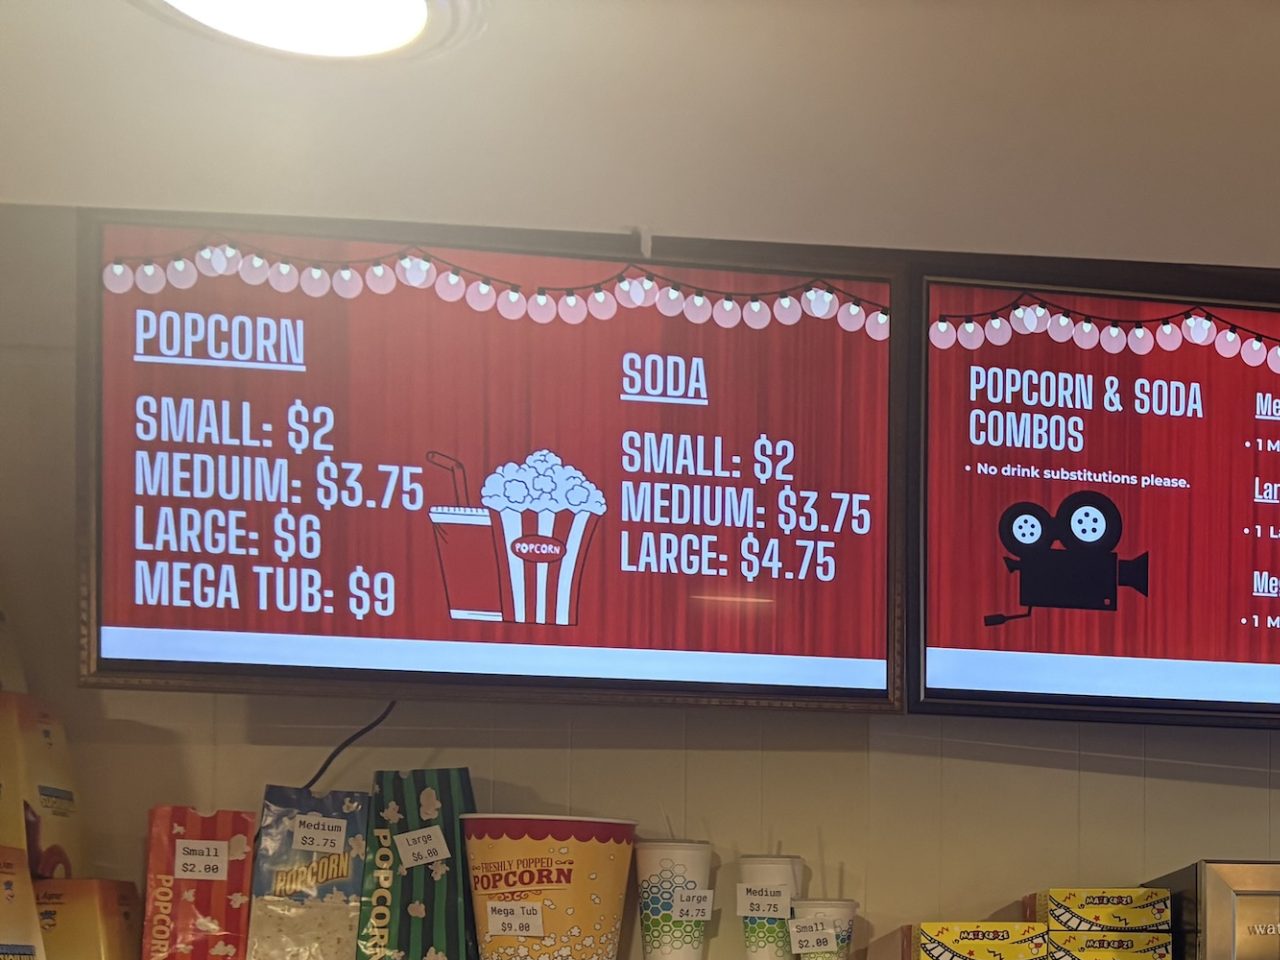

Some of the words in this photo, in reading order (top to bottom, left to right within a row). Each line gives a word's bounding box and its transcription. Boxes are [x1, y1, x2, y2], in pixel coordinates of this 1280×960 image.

[135, 308, 305, 364] POPCORN
[621, 351, 708, 399] SODA
[969, 365, 1094, 410] POPCORN
[1103, 375, 1123, 412] &
[1133, 377, 1204, 418] SODA
[135, 394, 273, 448] SMALL:
[287, 398, 336, 455] $2
[969, 408, 1085, 452] COMBOS
[1256, 438, 1264, 452] 1
[621, 430, 742, 479] SMALL:
[753, 432, 795, 485] $2
[134, 449, 302, 504] MEDUIM:
[316, 454, 424, 511] $3.75
[977, 462, 998, 476] No
[1001, 463, 1041, 479] drink
[1043, 466, 1139, 486] substitutions
[1140, 473, 1191, 489] please.
[620, 480, 766, 530] MEDIUM:
[777, 484, 871, 535] $3.75
[134, 504, 260, 556] LARGE:
[273, 507, 322, 563] $6
[1254, 524, 1263, 538] 1
[514, 541, 562, 556] POPCORN
[620, 530, 729, 577] LARGE:
[740, 531, 837, 582] $4.75
[134, 559, 241, 610] MEGA
[251, 565, 335, 614] TUB:
[348, 564, 396, 620] $9
[1252, 614, 1260, 628] 1
[298, 820, 342, 833] Medium
[300, 836, 337, 848] $3.75
[406, 832, 433, 848] Large
[181, 846, 219, 858] Small
[411, 847, 439, 862] $6.00
[181, 862, 219, 874] $2.00
[480, 859, 515, 872] FRESHLY
[516, 857, 554, 870] POPPED
[274, 852, 349, 897] POPCORN
[473, 868, 573, 891] POPCORN
[679, 893, 708, 904] Large
[745, 887, 782, 898] Medium
[490, 905, 515, 918] Mega
[520, 906, 538, 916] Tub
[678, 908, 706, 918] $4.75
[748, 903, 779, 914] $3.75
[500, 921, 531, 933] $9.00
[795, 922, 826, 934] Small
[797, 937, 830, 949] $2.00
